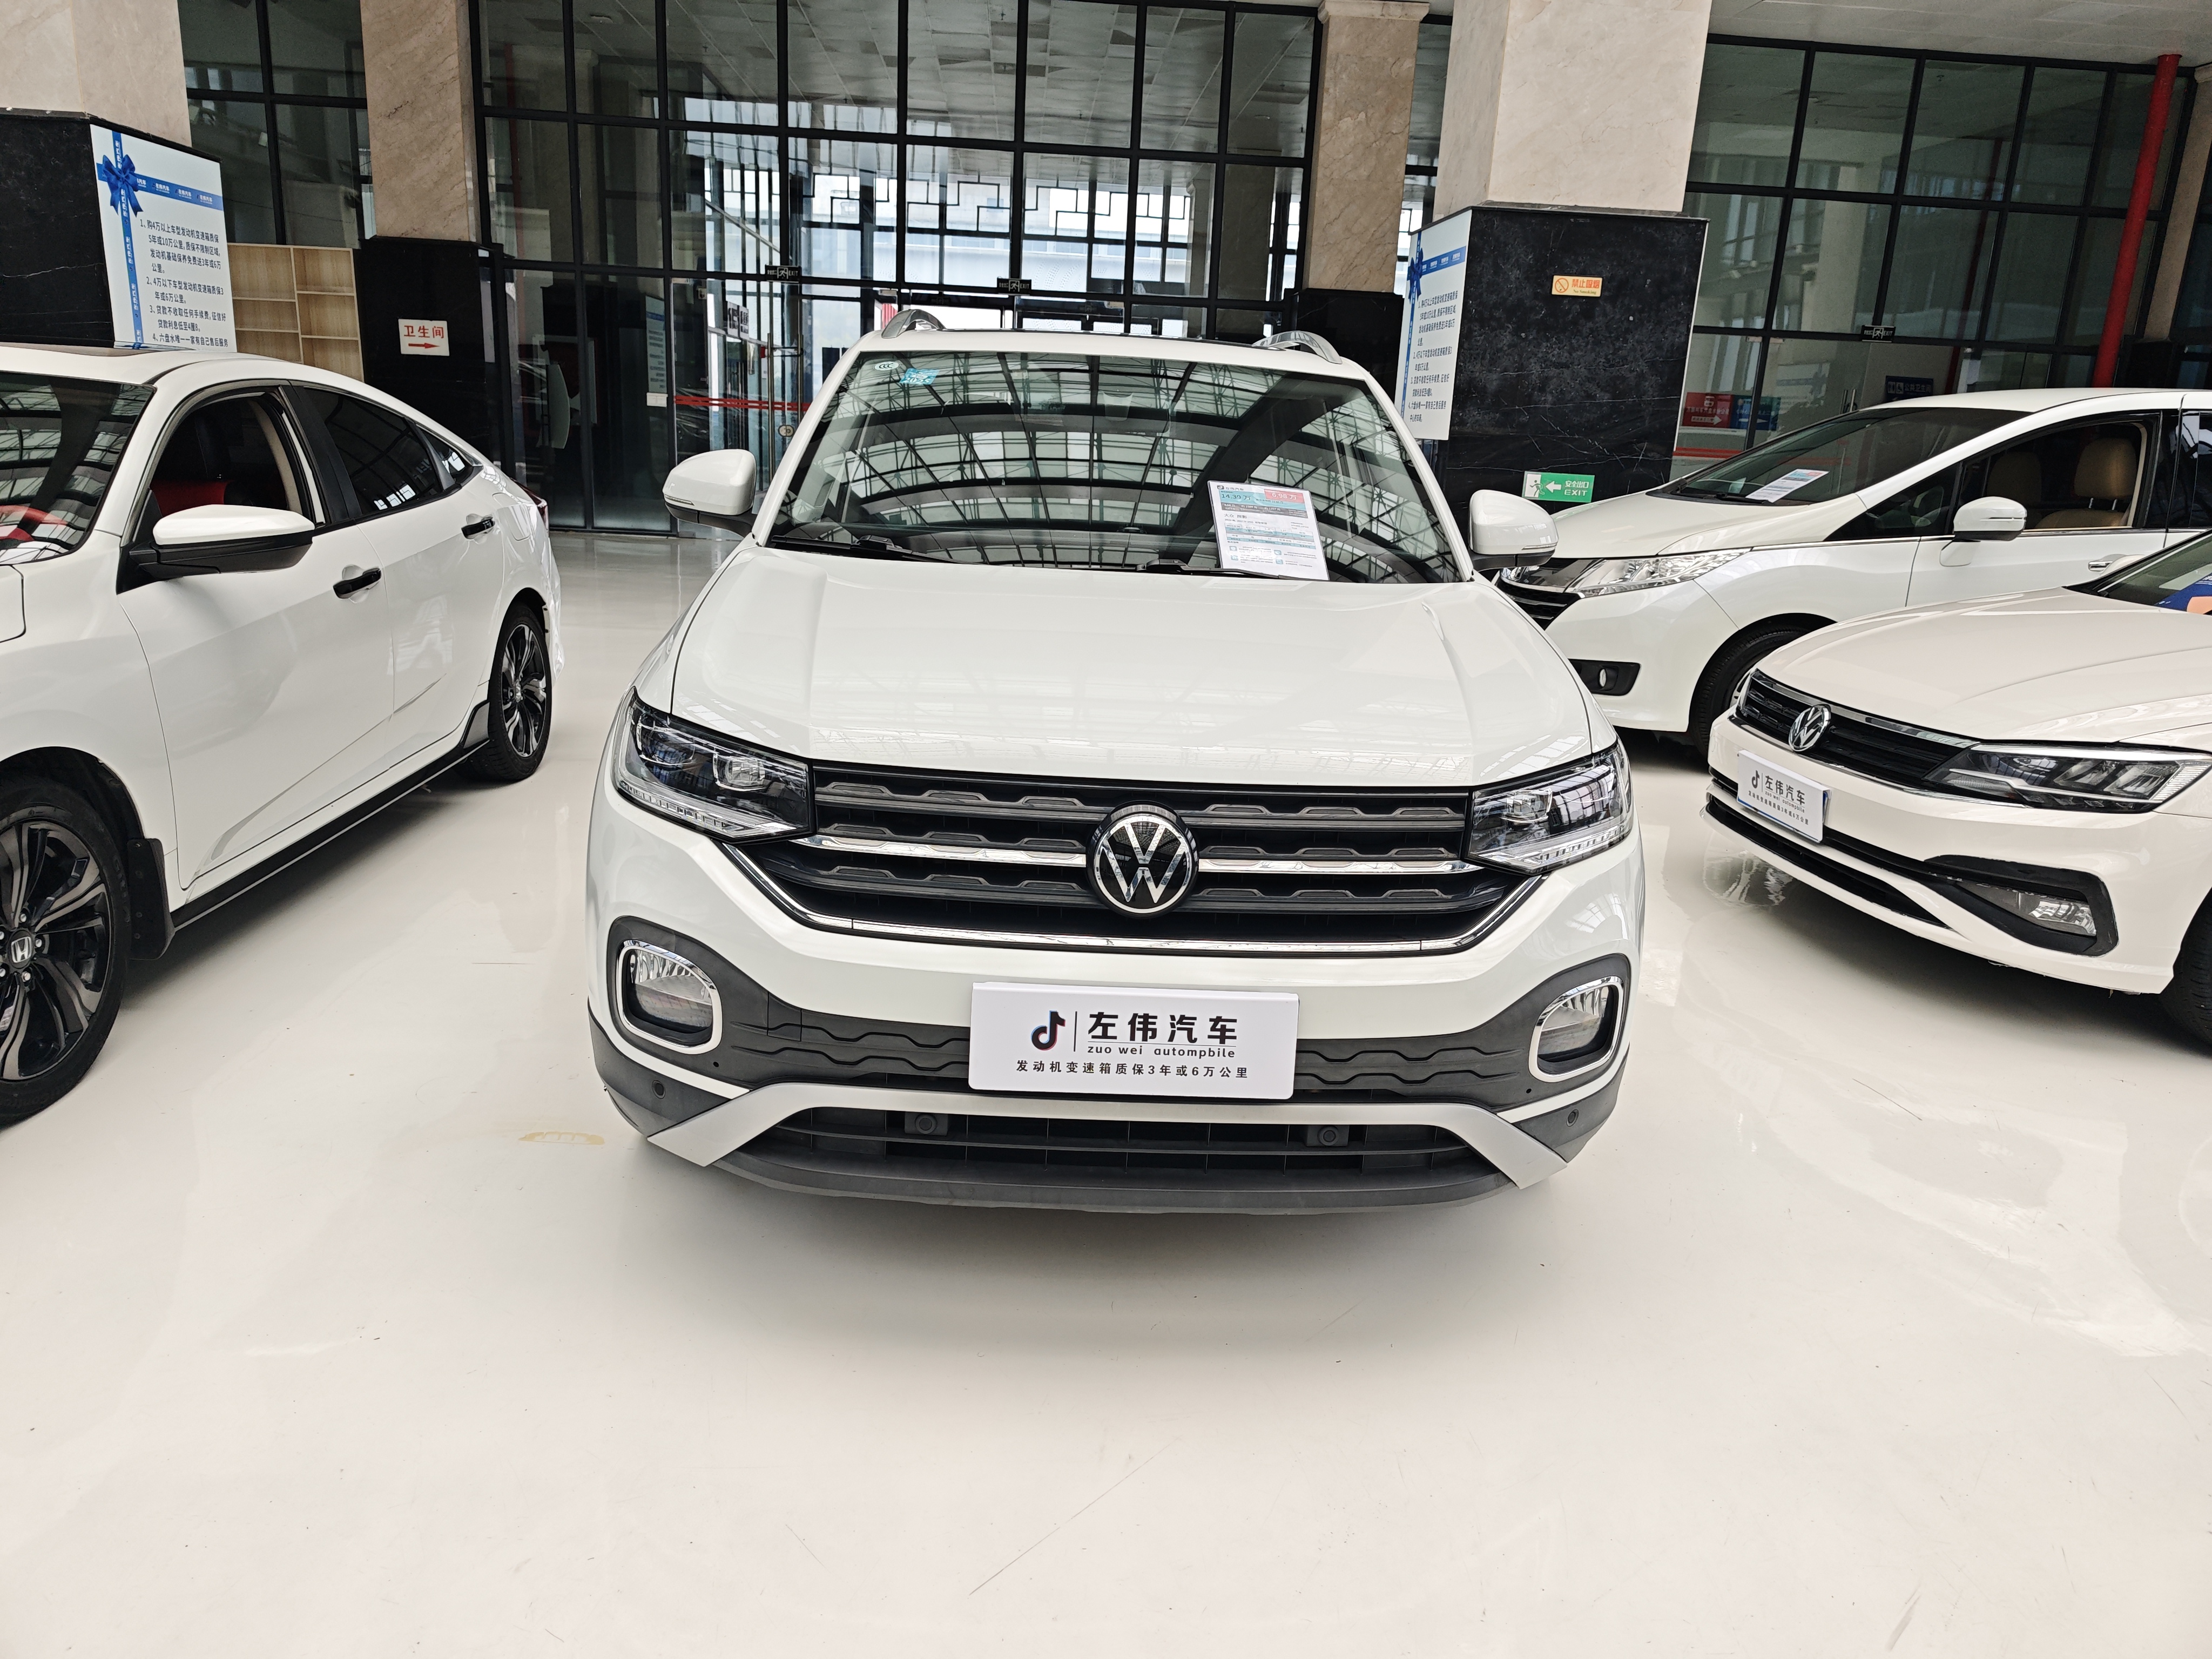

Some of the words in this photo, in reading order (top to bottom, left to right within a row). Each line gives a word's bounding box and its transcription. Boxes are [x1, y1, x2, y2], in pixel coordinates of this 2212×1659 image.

[403, 325, 444, 339] 卫生间
[1565, 480, 1589, 488] 安全出口
[1765, 775, 1805, 805] 左伟汽车
[1088, 1011, 1238, 1044] 左伟汽车
[1087, 1046, 1112, 1055] zuo
[1118, 1045, 1143, 1056] wei
[1154, 1046, 1236, 1059] autompbile
[1016, 1060, 1248, 1078] 发动机变速箱质保3年或6万公里
